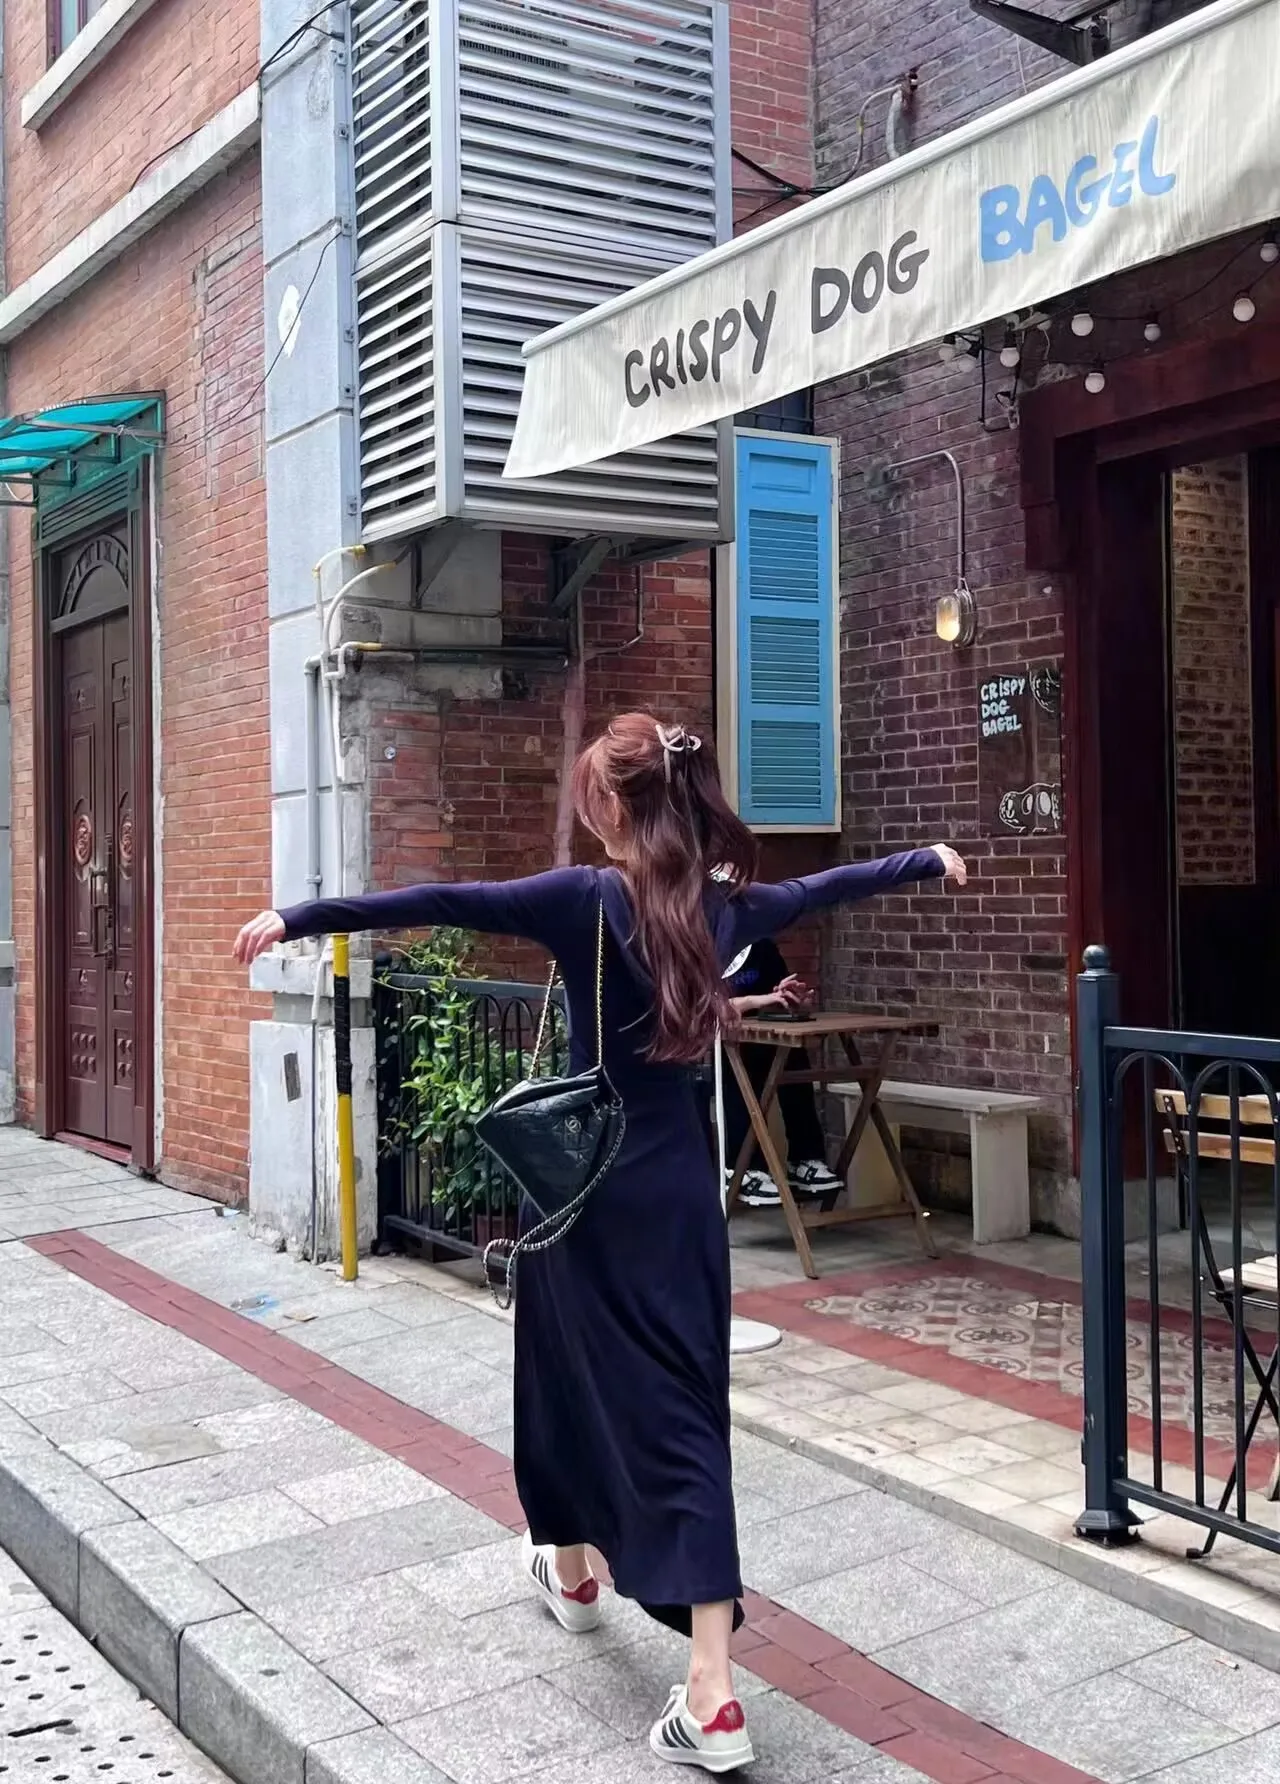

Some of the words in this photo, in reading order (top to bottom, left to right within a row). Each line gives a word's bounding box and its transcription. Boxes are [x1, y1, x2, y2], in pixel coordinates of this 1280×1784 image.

[624, 290, 777, 409] CRISPY
[811, 230, 930, 334] DOG
[979, 115, 1177, 265] BAGEL
[981, 699, 1011, 719] DOG
[982, 714, 1023, 737] BAGEL
